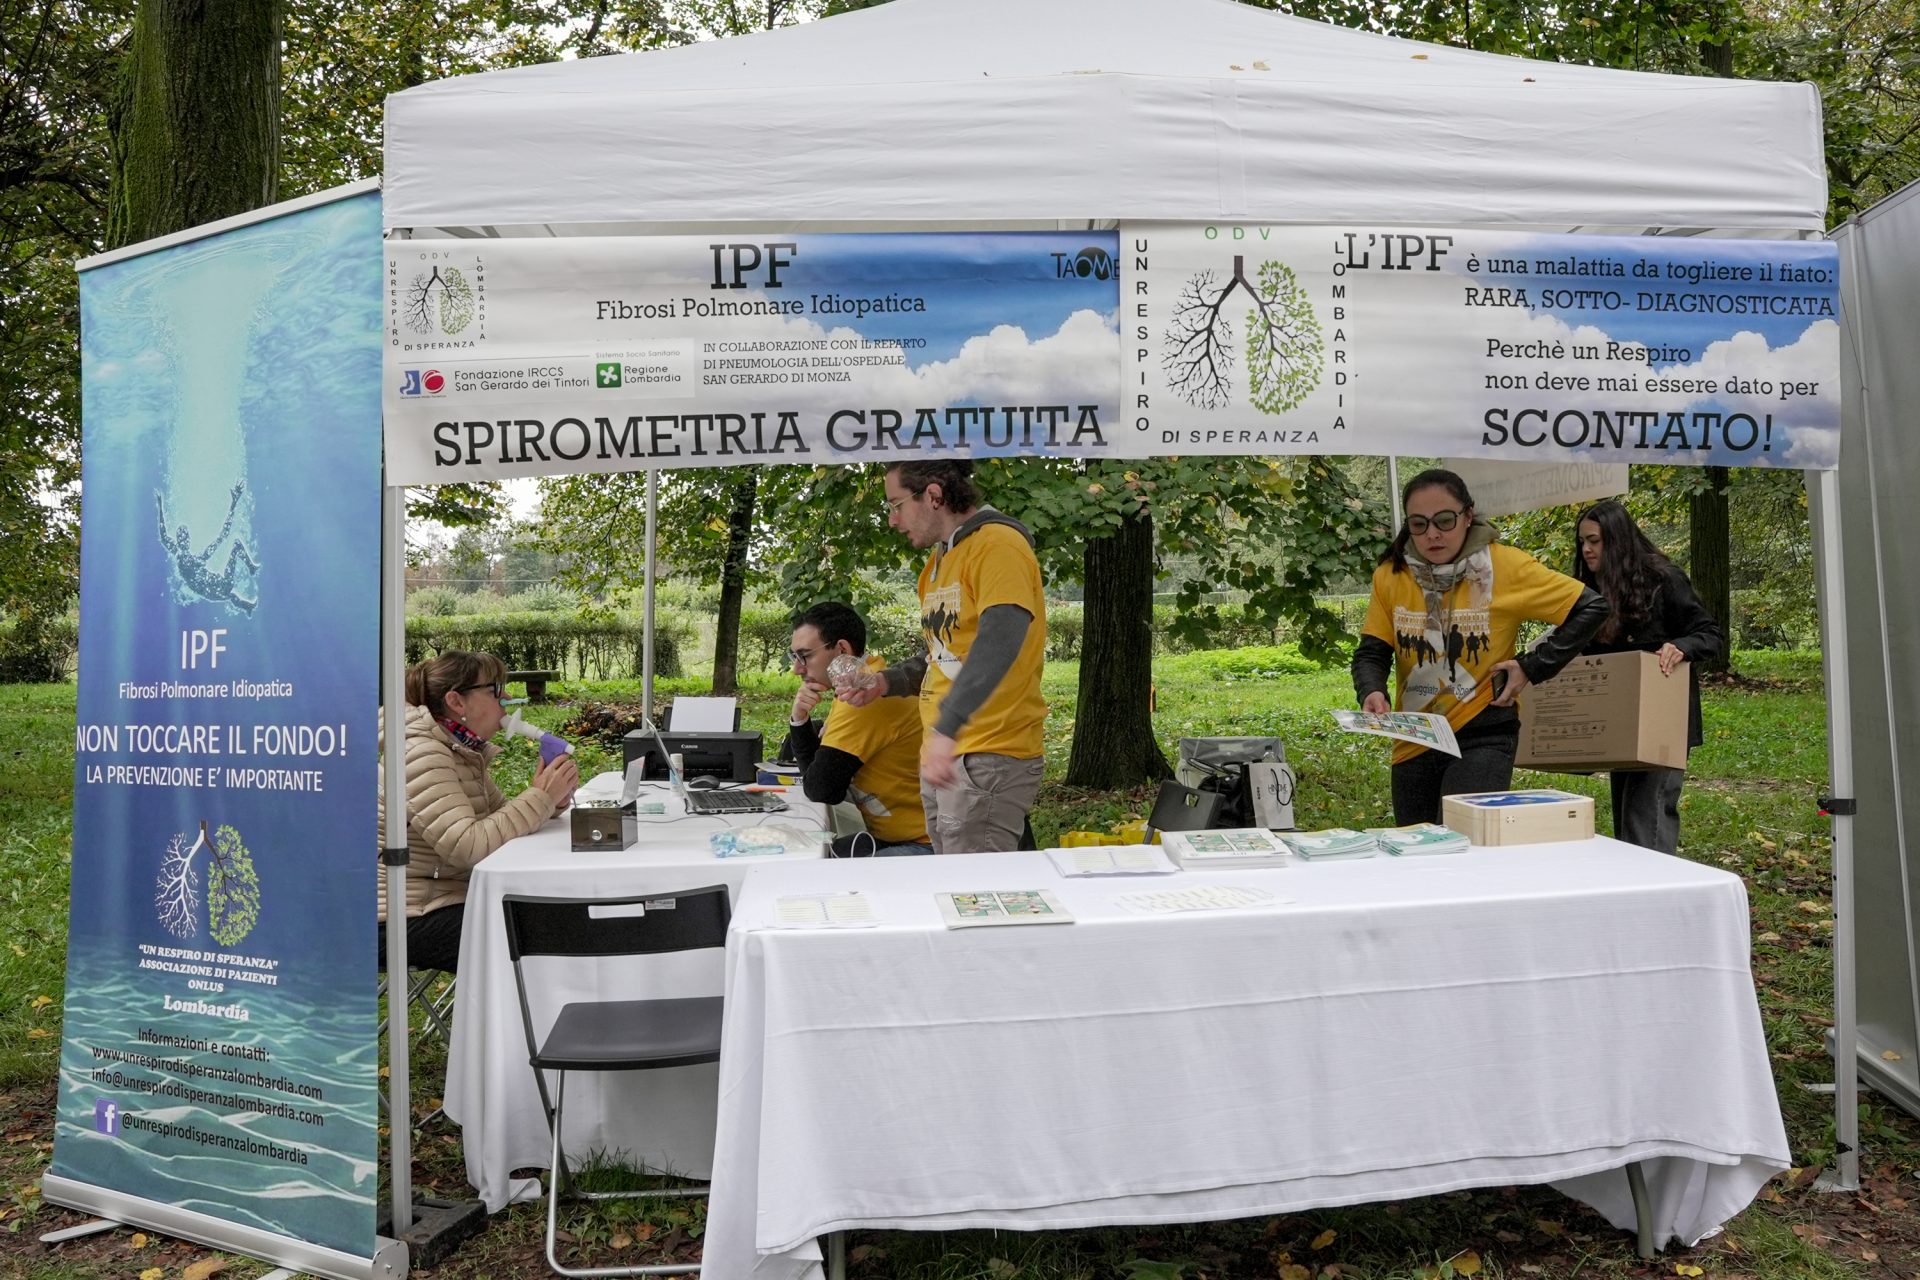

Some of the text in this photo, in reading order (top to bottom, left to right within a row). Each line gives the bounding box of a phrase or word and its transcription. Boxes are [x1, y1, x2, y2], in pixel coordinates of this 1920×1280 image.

[710, 243, 796, 289] IPF
[1467, 254, 1834, 284] è una malattia da togliere il fiato:
[476, 256, 486, 340] LOMBARDIA
[596, 293, 926, 320] Fibrosi Polmonare Idiopatica
[1465, 288, 1834, 316] RARA, SOTTO- DIAGNOSTICATA
[416, 340, 474, 350] SPERANZA
[704, 338, 926, 353] IN COLLABORAZIONE CON IL REPARTO
[1332, 241, 1346, 430] LOMBARDIA
[704, 360, 716, 370] DI
[719, 357, 808, 370] PNEUMOLOGIA
[1486, 338, 1691, 366] Perchè un Respiro
[454, 366, 564, 381] Fondazione IRCCS
[624, 364, 668, 375] Regione
[624, 374, 681, 384] Lombardia
[703, 372, 852, 384] SAN GERARDO DI MONZA
[454, 376, 590, 392] San Gerardo dei Tintori
[1485, 372, 1818, 400] non deve mai essere dato per
[434, 404, 1108, 466] SPIROMETRIA GRATUITA
[1162, 430, 1319, 443] DI SPERANZA
[1482, 408, 1772, 452] SCONTATO!
[181, 629, 227, 669] IPF
[119, 679, 292, 700] Fibrosi Polmonare Idiopatica
[76, 725, 117, 752] NON
[125, 726, 220, 754] TOCCARE
[229, 726, 246, 754] IL
[86, 765, 102, 784] LA
[108, 766, 203, 786] PREVENZIONE
[226, 769, 322, 792] IMPORTANTE
[158, 946, 200, 960] RESPIRO
[203, 951, 215, 962] DI
[139, 958, 278, 985] ASSOCIAZIONE DI PAZIENTI
[188, 980, 224, 992] ONLUS
[164, 995, 250, 1021] Lombardia
[138, 1028, 270, 1062] Informazioni e contatti:
[92, 1047, 322, 1100] www.unrespirodisperanzalombardia.com
[92, 1068, 324, 1126] info@unrespirodisperanzalombardia.com
[122, 1112, 308, 1165] @unrespirodisperanzalombardia
